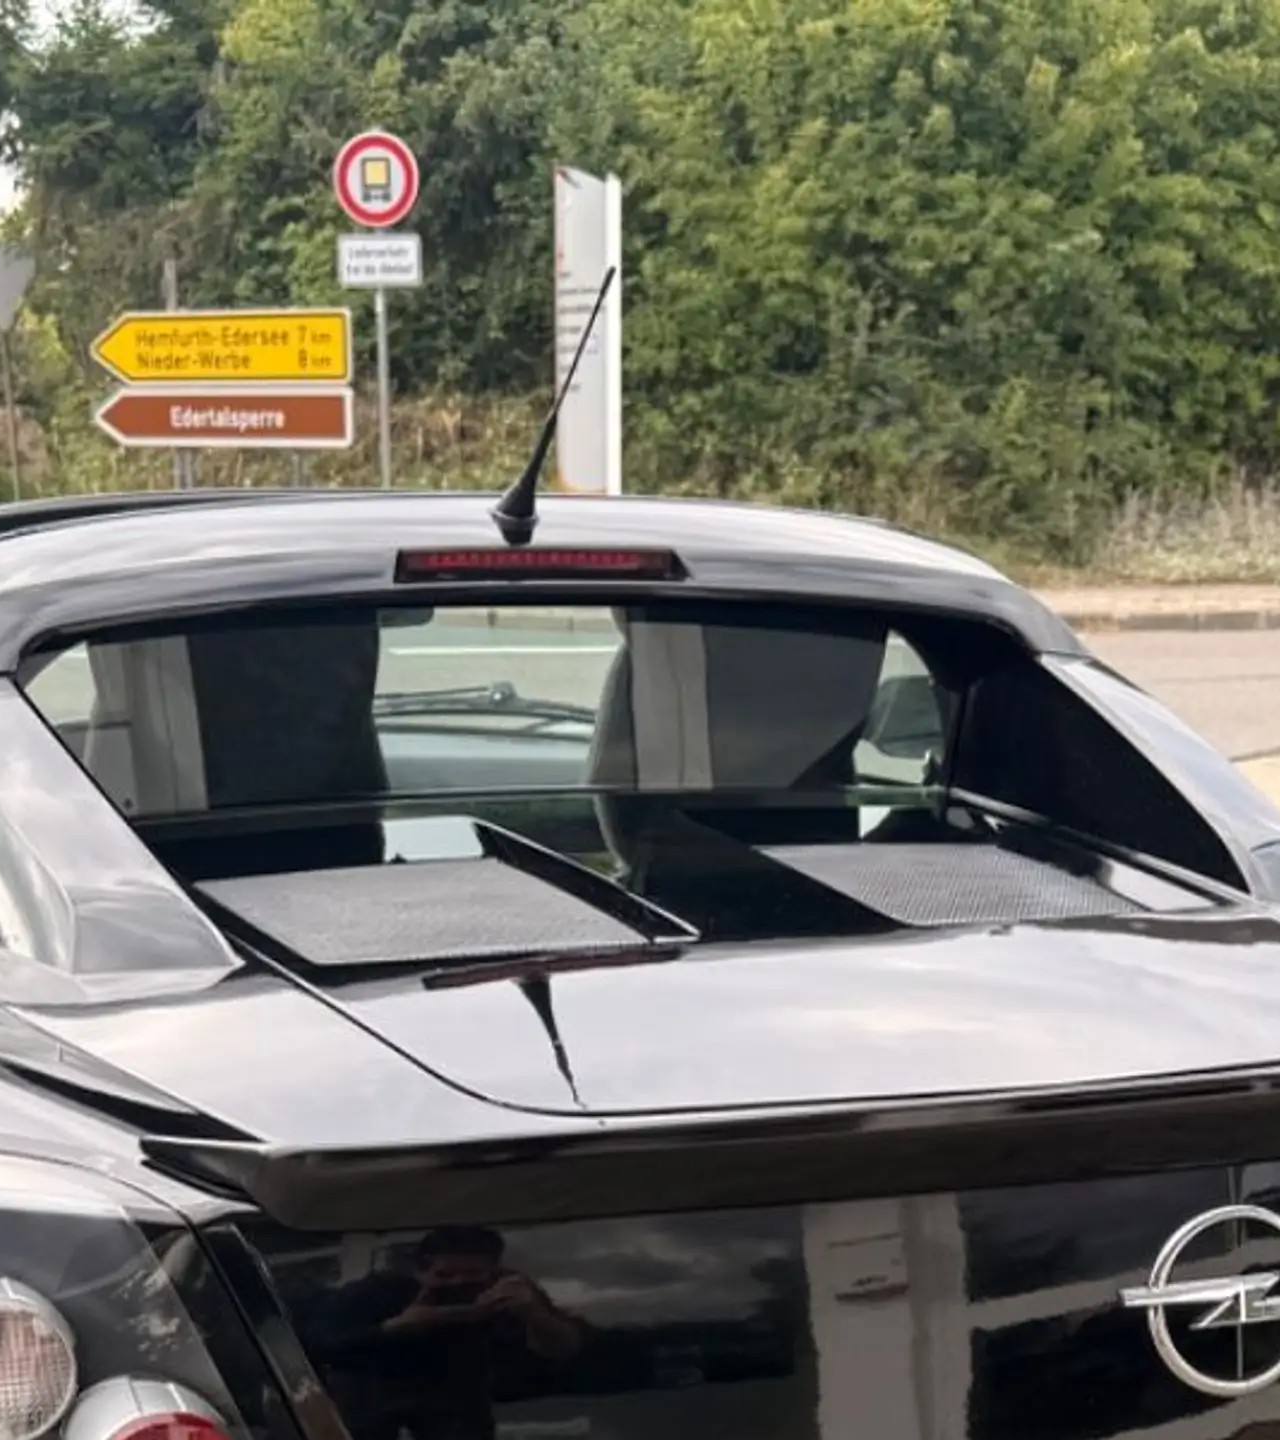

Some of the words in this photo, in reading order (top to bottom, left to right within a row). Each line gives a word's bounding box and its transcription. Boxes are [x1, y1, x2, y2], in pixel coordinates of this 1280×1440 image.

[135, 326, 289, 349] Hemfurth-Edersee
[136, 351, 251, 370] Nieder-Werbe
[169, 405, 286, 432] Edertalsperre
